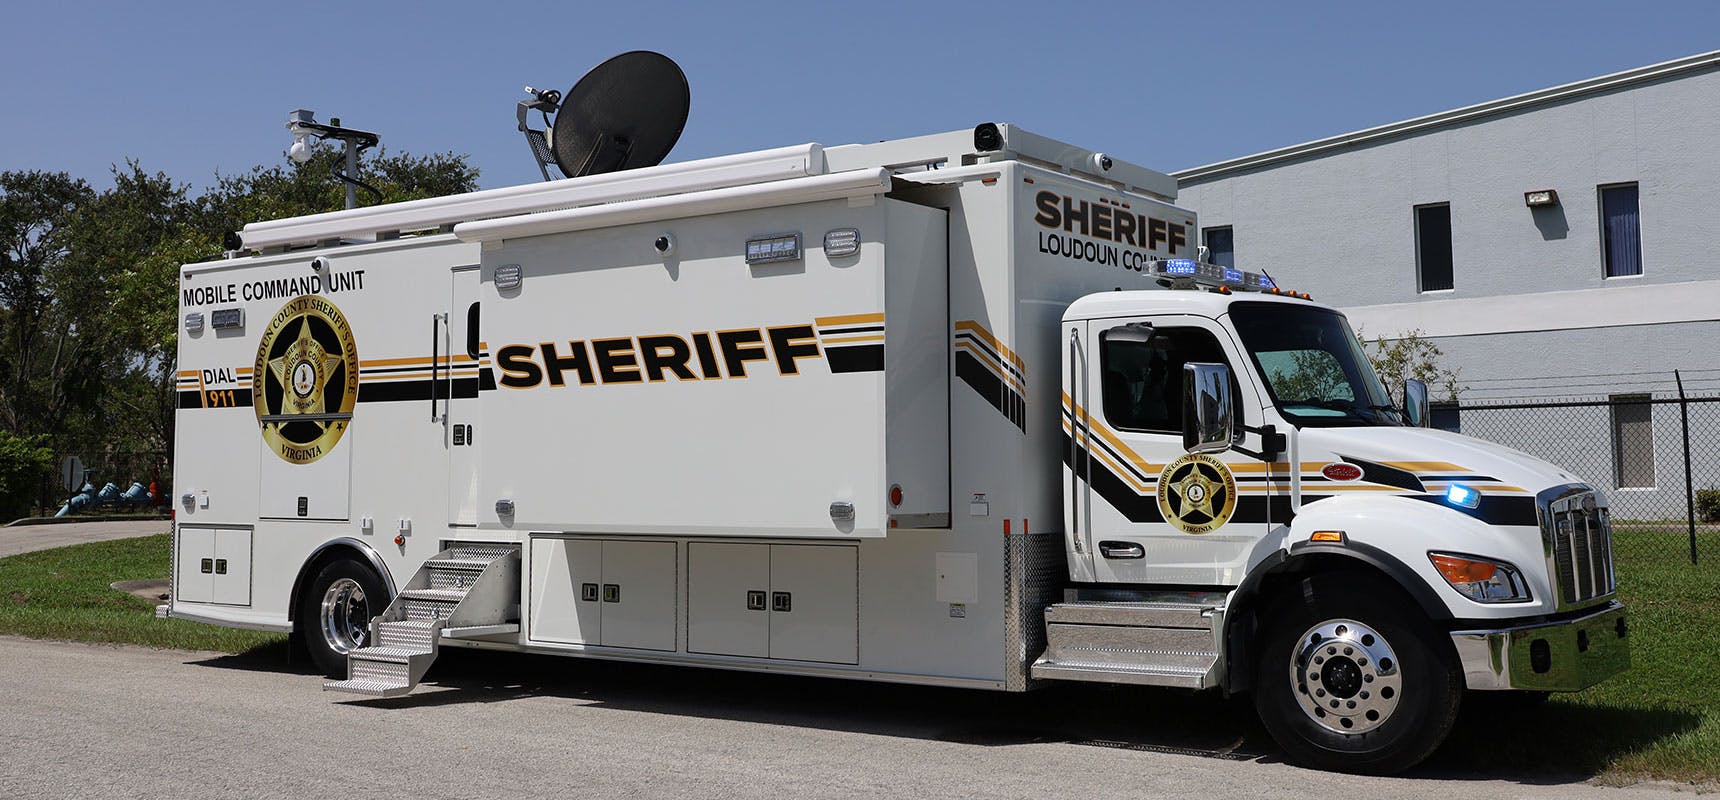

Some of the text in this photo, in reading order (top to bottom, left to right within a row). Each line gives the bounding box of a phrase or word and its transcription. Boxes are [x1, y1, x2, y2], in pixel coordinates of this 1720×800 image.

[1034, 190, 1186, 254] SHERIFF
[1039, 231, 1118, 267] LOUDOUN
[183, 270, 365, 307] MOBILE COMMAND UNIT
[255, 298, 357, 398] LOUDOUN COUNTY SHERIFF'S OFFICE
[496, 323, 822, 389] SHERIFF
[203, 367, 236, 385] DIAL
[209, 390, 235, 407] 911
[281, 444, 322, 460] VIRGINIA
[1183, 525, 1213, 533] VIRGINIA
